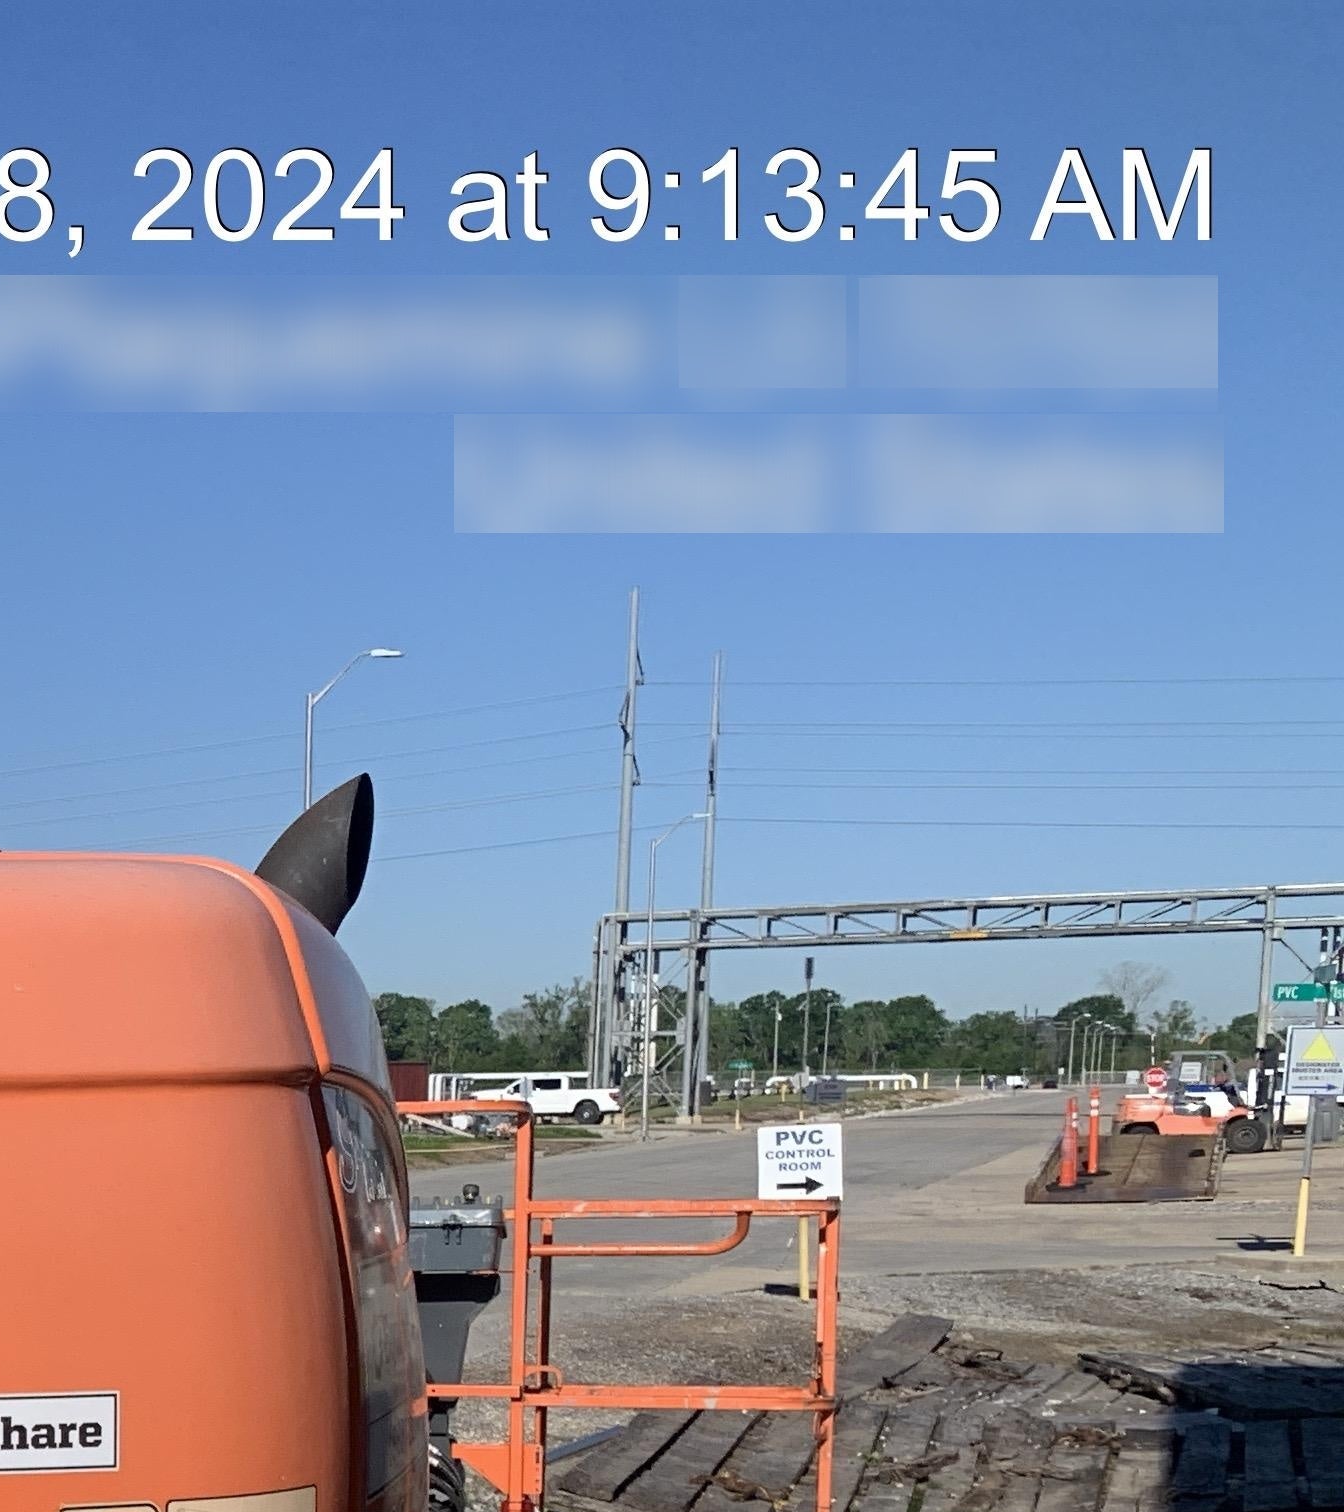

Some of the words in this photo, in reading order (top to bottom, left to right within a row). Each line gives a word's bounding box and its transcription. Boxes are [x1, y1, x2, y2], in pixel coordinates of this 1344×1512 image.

[1277, 986, 1299, 999] PVC
[775, 1129, 824, 1146] PVC
[765, 1148, 835, 1160] CONTROL
[778, 1161, 822, 1172] ROOM
